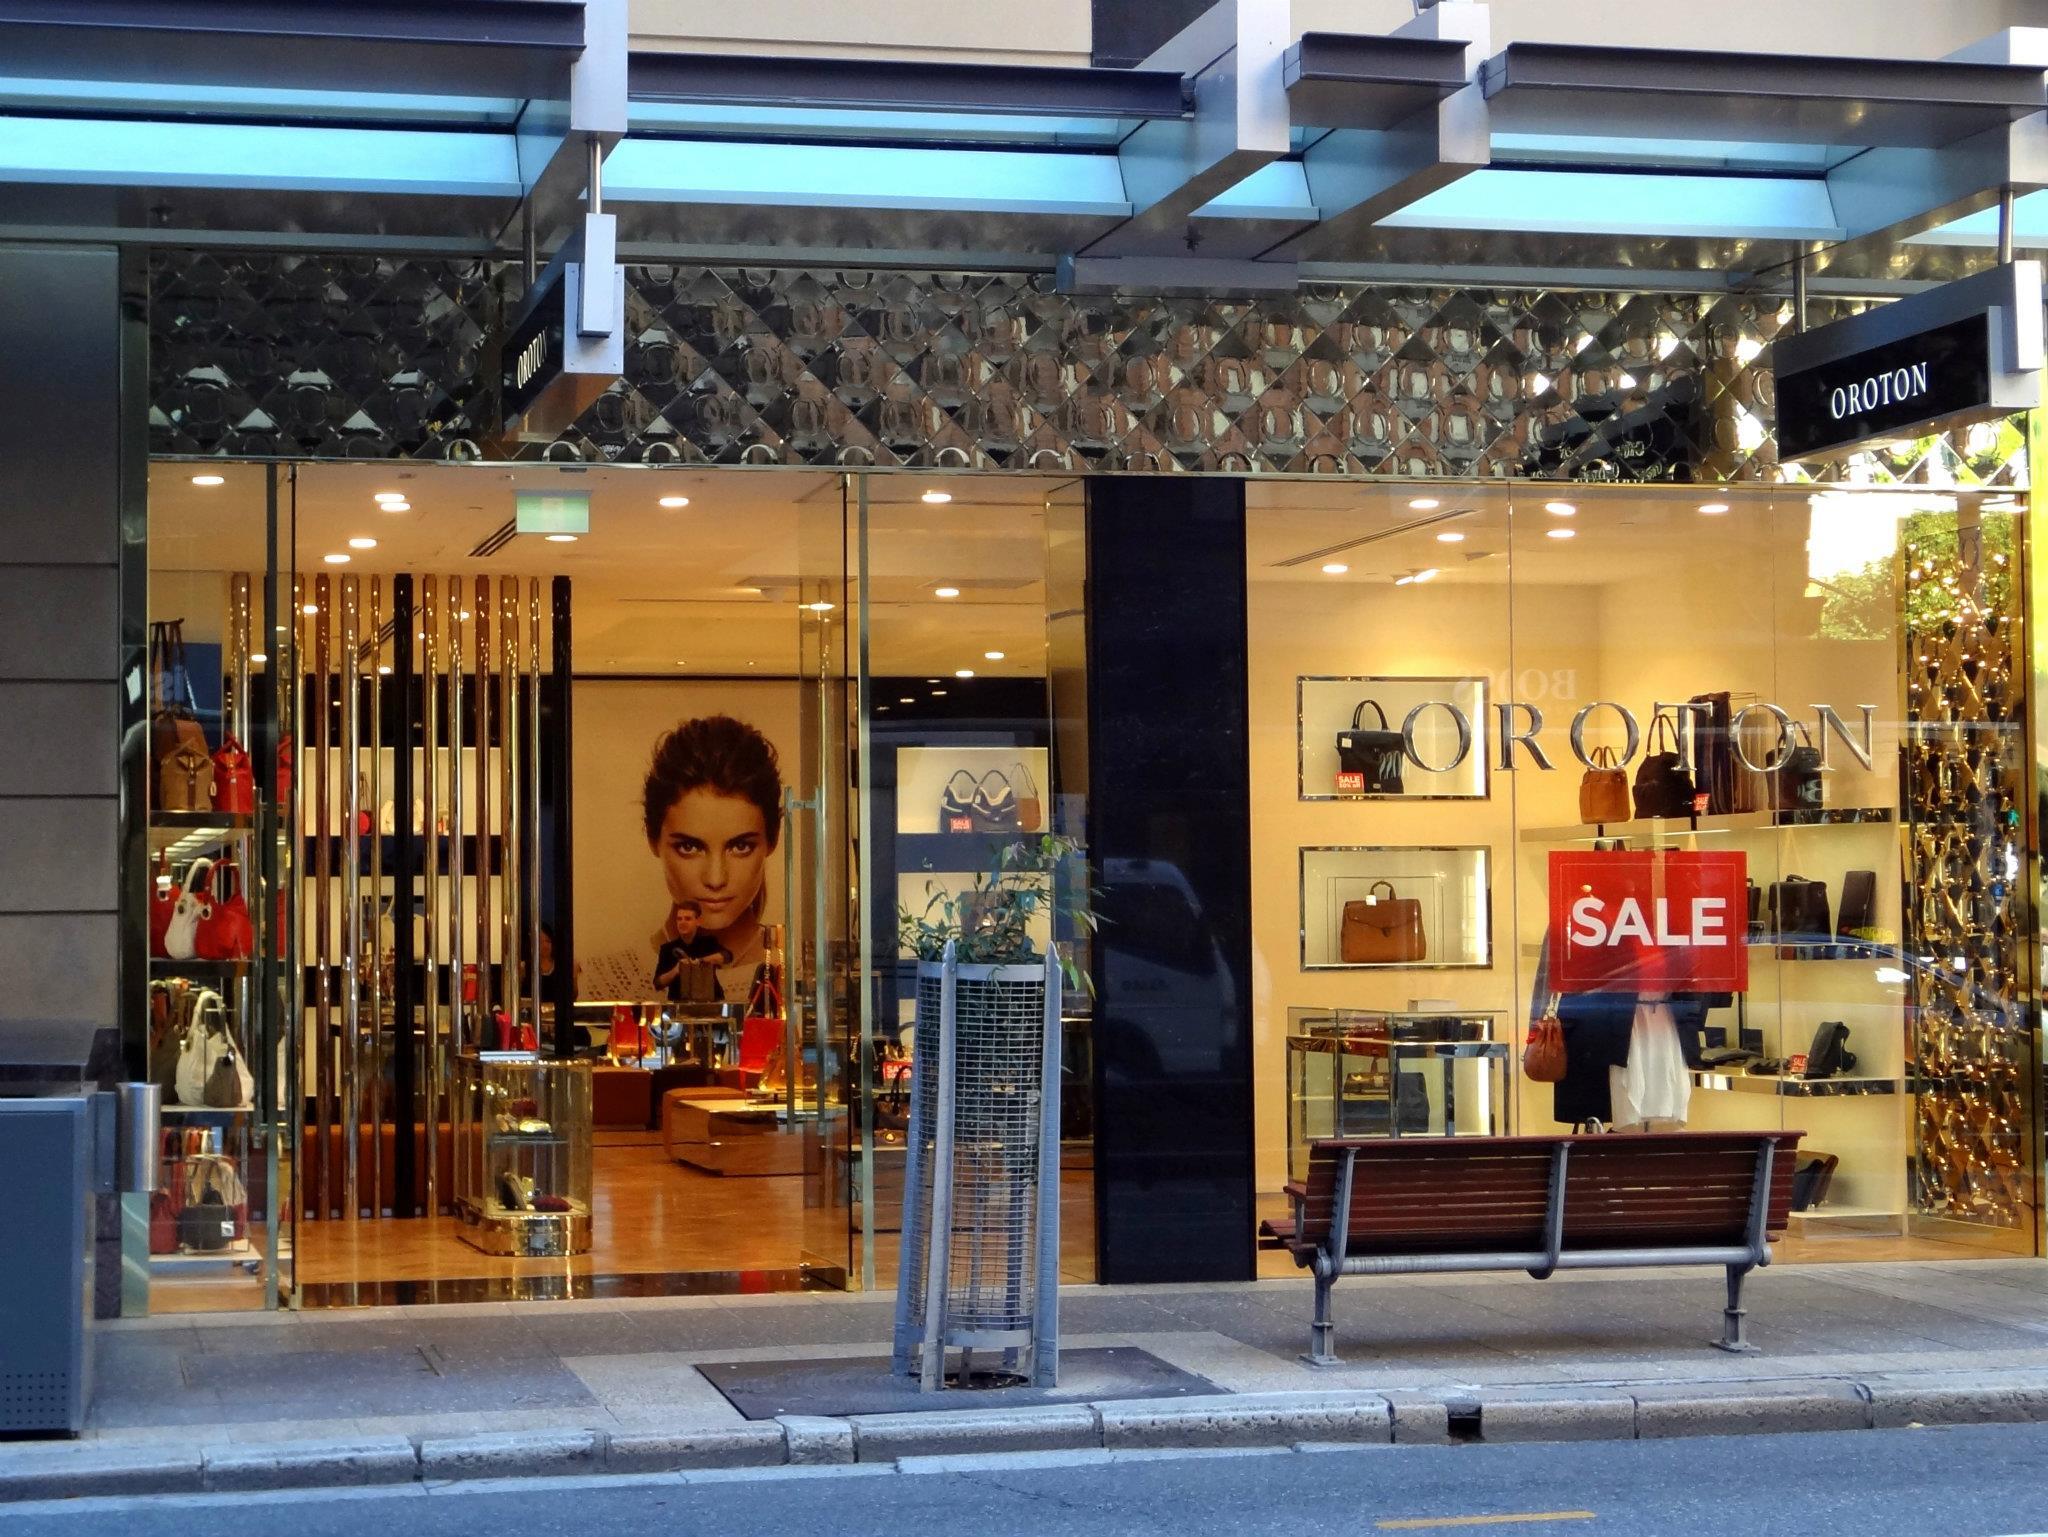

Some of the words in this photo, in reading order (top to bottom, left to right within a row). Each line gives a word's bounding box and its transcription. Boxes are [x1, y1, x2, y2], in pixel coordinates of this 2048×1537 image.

[1831, 361, 1927, 419] OROTON
[1401, 701, 1879, 772] OROTON
[1338, 775, 1361, 783] SALE
[1571, 897, 1728, 947] SALE
